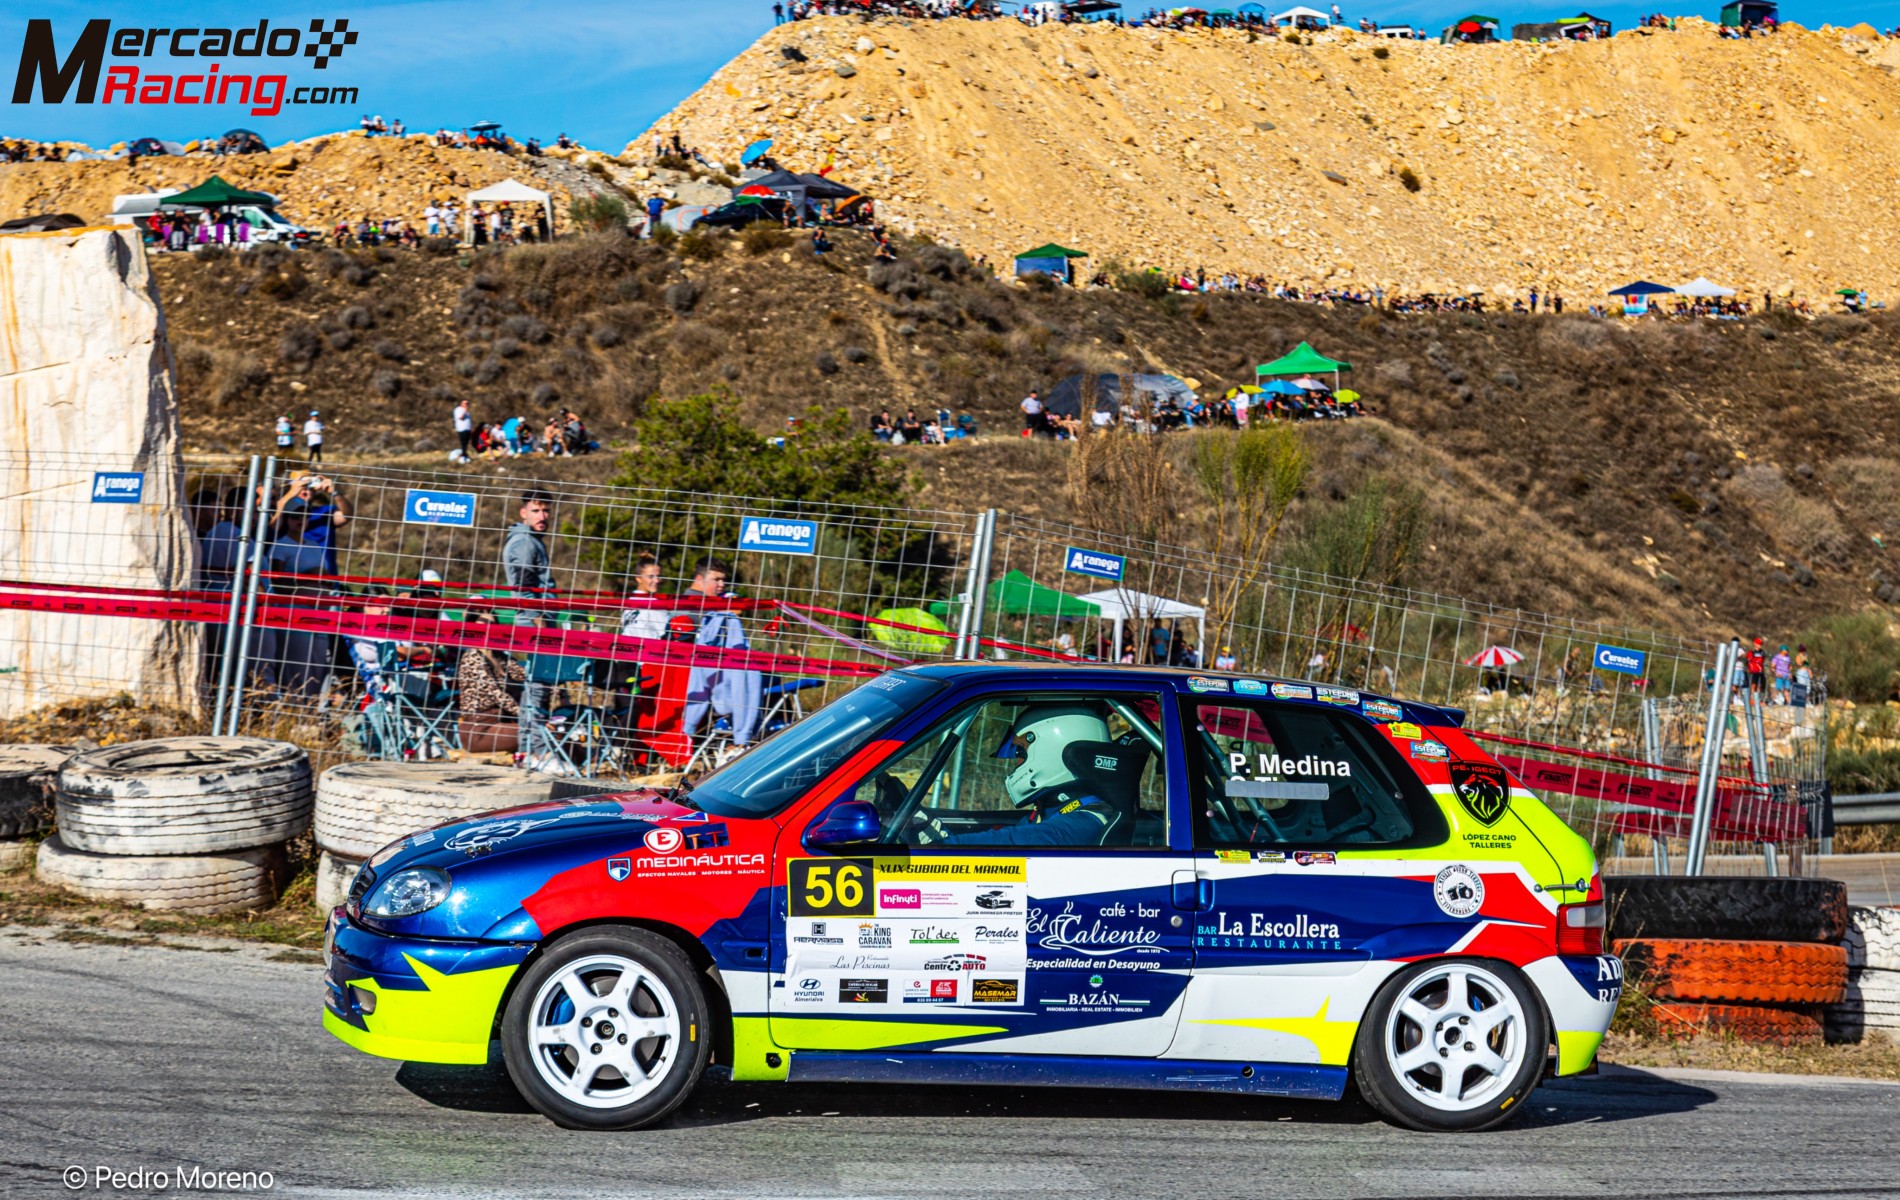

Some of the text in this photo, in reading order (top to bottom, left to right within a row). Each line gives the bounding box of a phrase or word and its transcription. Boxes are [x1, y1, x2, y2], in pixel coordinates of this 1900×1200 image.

[94, 476, 140, 497] Aranega
[742, 520, 811, 544] Aranega
[1070, 552, 1120, 571] Aranega
[1095, 757, 1117, 768] OMP
[1230, 753, 1352, 777] P. Medina
[1463, 833, 1490, 841] LÓPEZ
[637, 853, 765, 869] MEDINÁUTICA
[879, 864, 905, 874] XLIX
[907, 864, 949, 875] SUBIDA
[951, 864, 971, 875] DEL
[804, 865, 864, 909] 56
[1099, 902, 1126, 917] café
[1138, 902, 1161, 918] bar
[874, 927, 892, 937] KING
[975, 925, 1019, 939] Perales
[1054, 914, 1161, 944] Caliente
[1198, 912, 1340, 939] BAR La Escollera
[858, 937, 892, 945] CARAVAN
[1197, 937, 1341, 950] RESTAURANTE
[852, 955, 890, 970] Piscinas
[962, 963, 986, 971] AUTO
[1026, 958, 1161, 972] Especialidad en Desayuno
[973, 990, 1017, 998] MASEMAR
[1068, 991, 1119, 1005] BAZÁN
